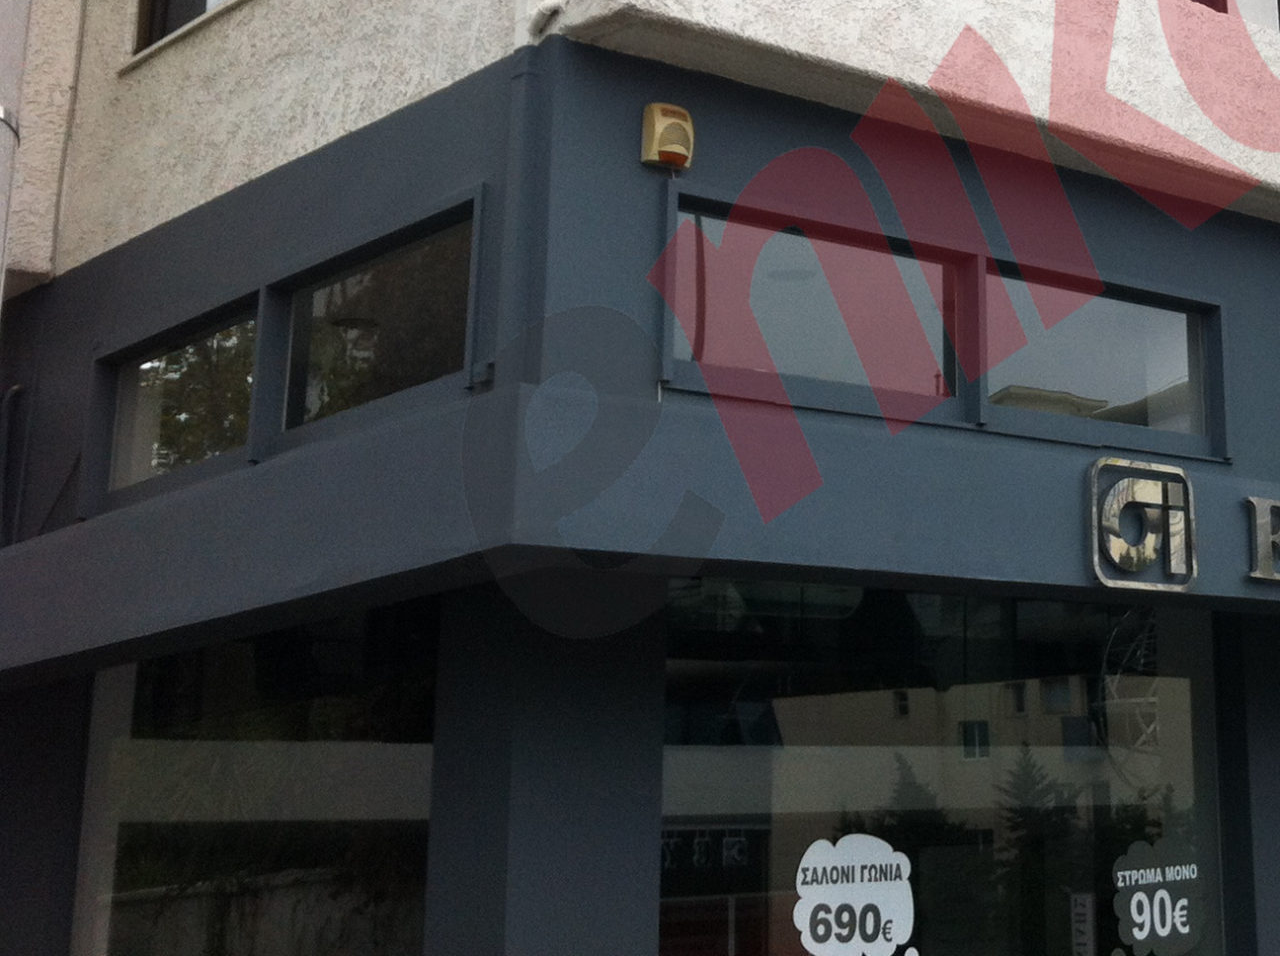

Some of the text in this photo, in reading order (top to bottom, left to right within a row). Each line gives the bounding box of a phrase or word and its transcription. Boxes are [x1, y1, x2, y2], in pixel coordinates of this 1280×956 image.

[801, 862, 903, 886] ΣΑΛΟΝΙ ΓΩΝΙΑ
[1117, 863, 1198, 888] ΣΤΡΩΜΑ ΜΟΝΟ
[808, 902, 894, 945] 690€
[1129, 888, 1190, 941] 90€
